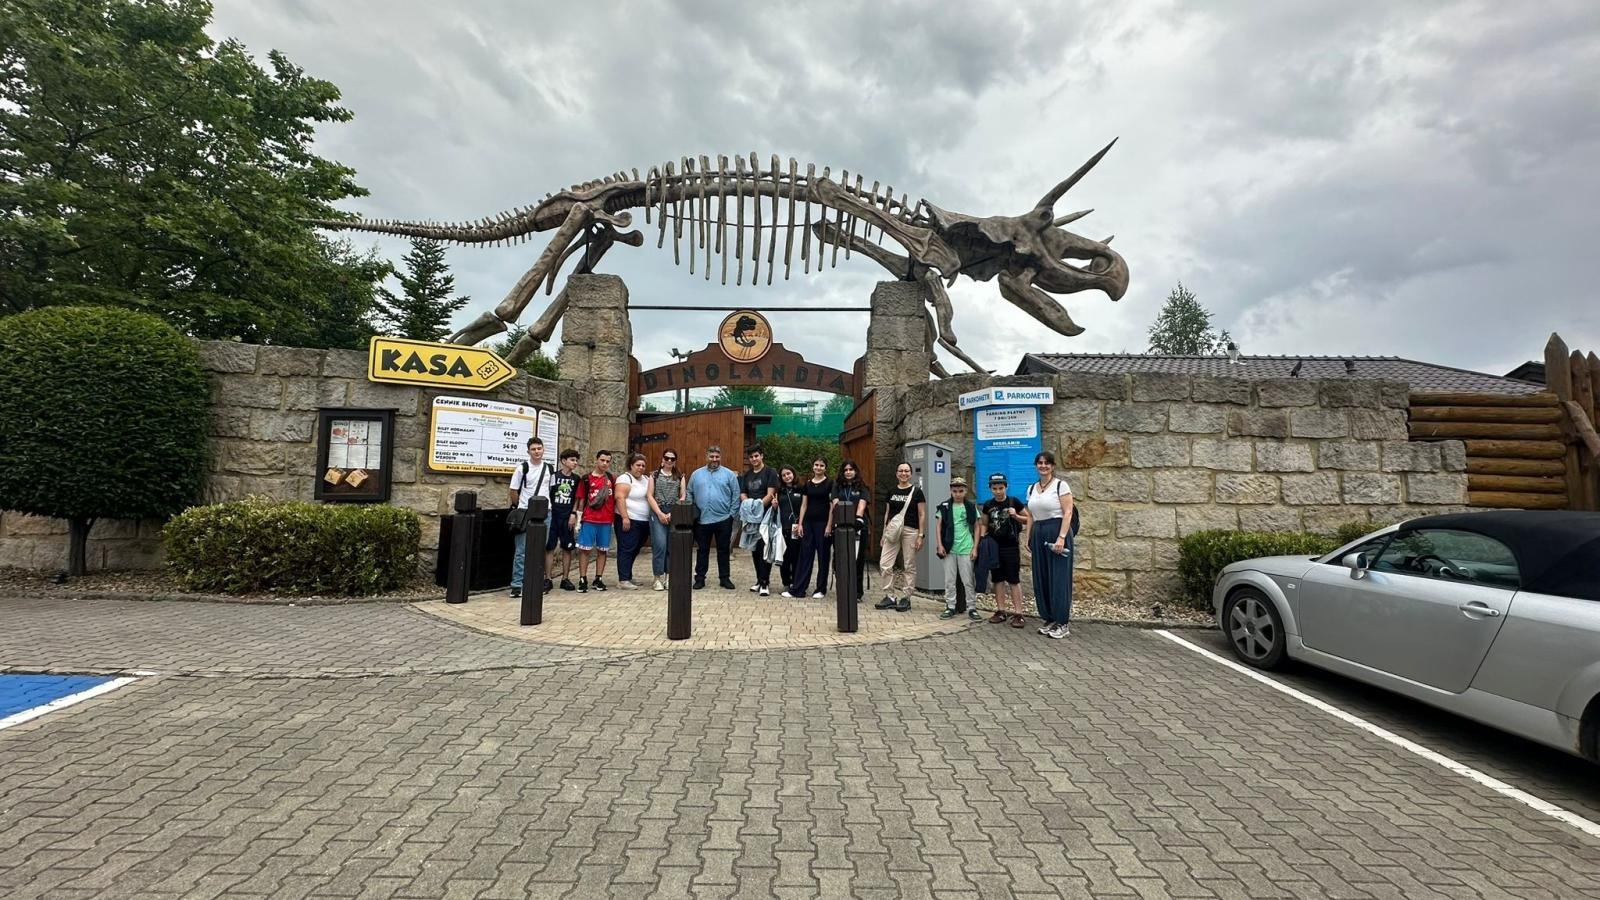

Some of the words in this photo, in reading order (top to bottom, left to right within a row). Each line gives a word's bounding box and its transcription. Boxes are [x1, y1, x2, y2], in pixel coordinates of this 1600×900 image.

[381, 349, 473, 378] KASA
[644, 363, 845, 391] DINOLANDIA
[966, 394, 990, 404] PARKOMETR
[1007, 392, 1050, 400] PARKOMETR
[435, 398, 460, 406] CENNIK
[936, 462, 943, 472] P
